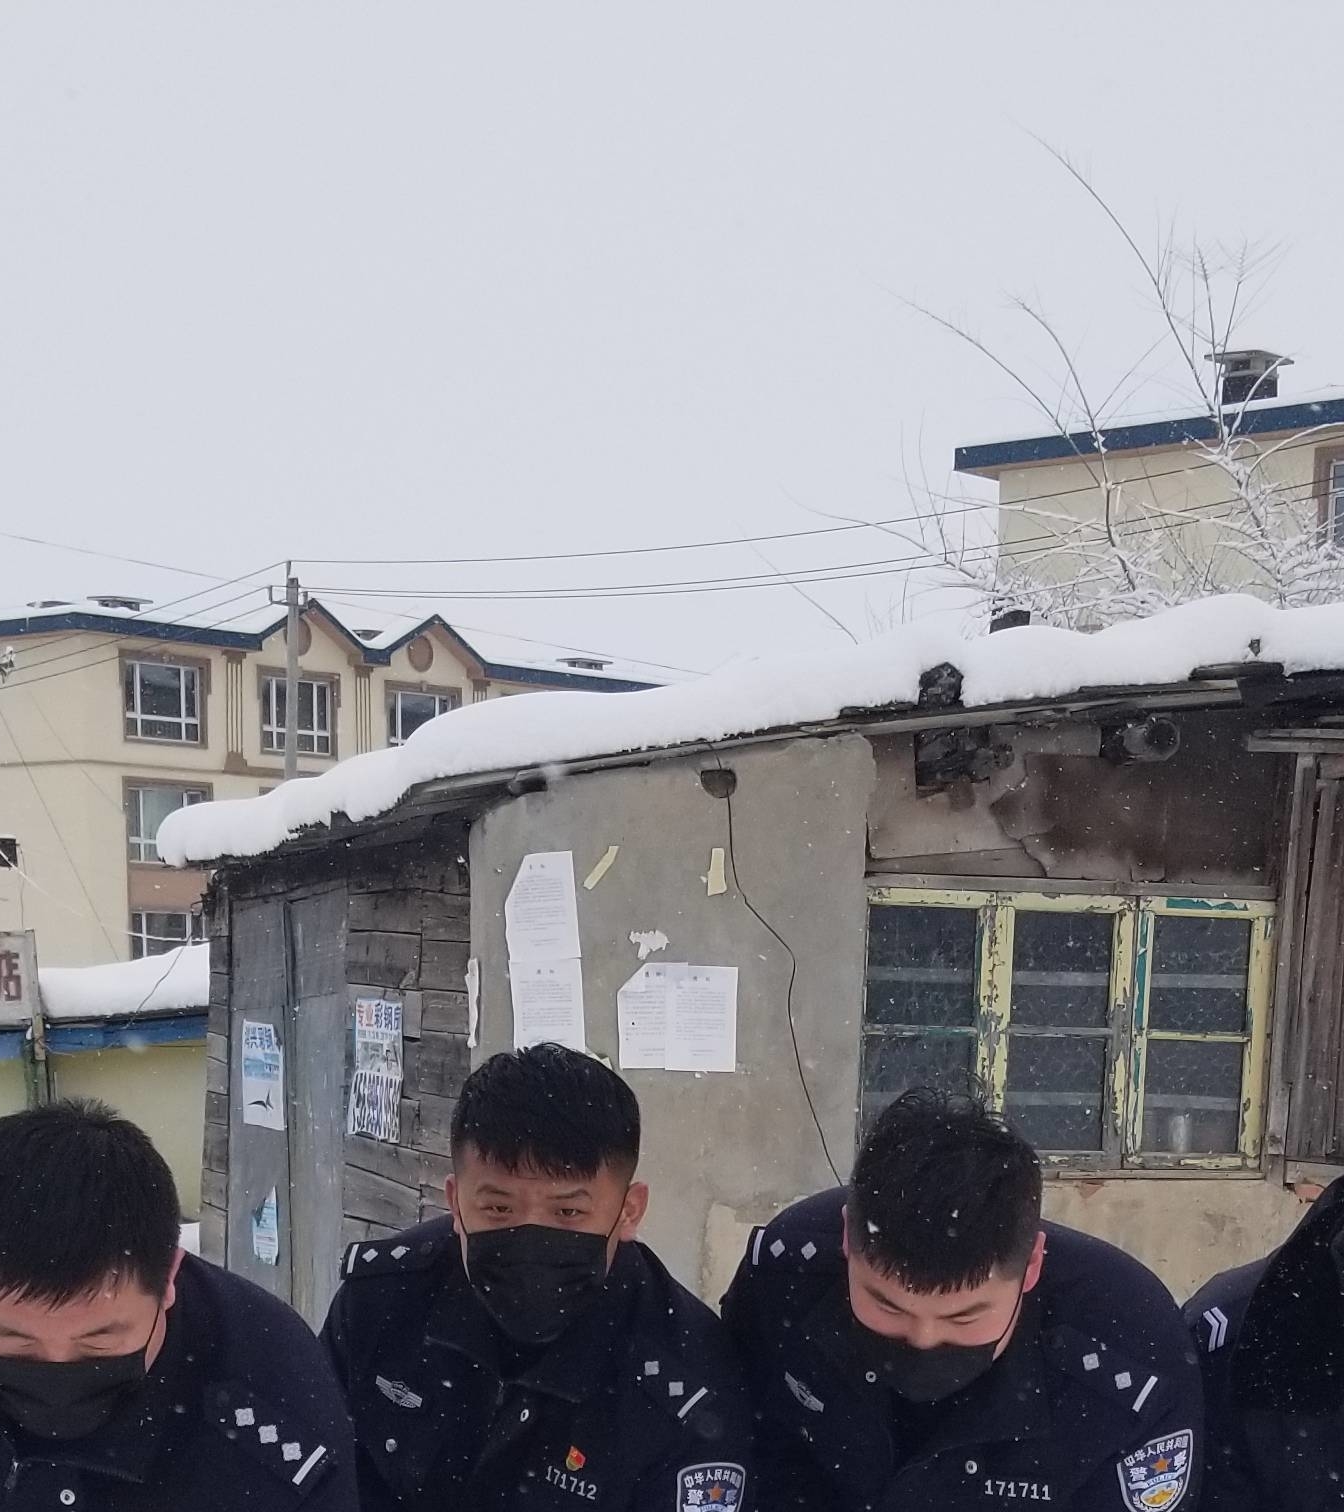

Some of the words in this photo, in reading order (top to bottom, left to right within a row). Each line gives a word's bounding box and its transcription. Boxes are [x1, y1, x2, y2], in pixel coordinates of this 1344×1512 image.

[1123, 1435, 1189, 1467] 中华人民共和国
[544, 1465, 598, 1501] 171712
[984, 1479, 1052, 1502] 171711
